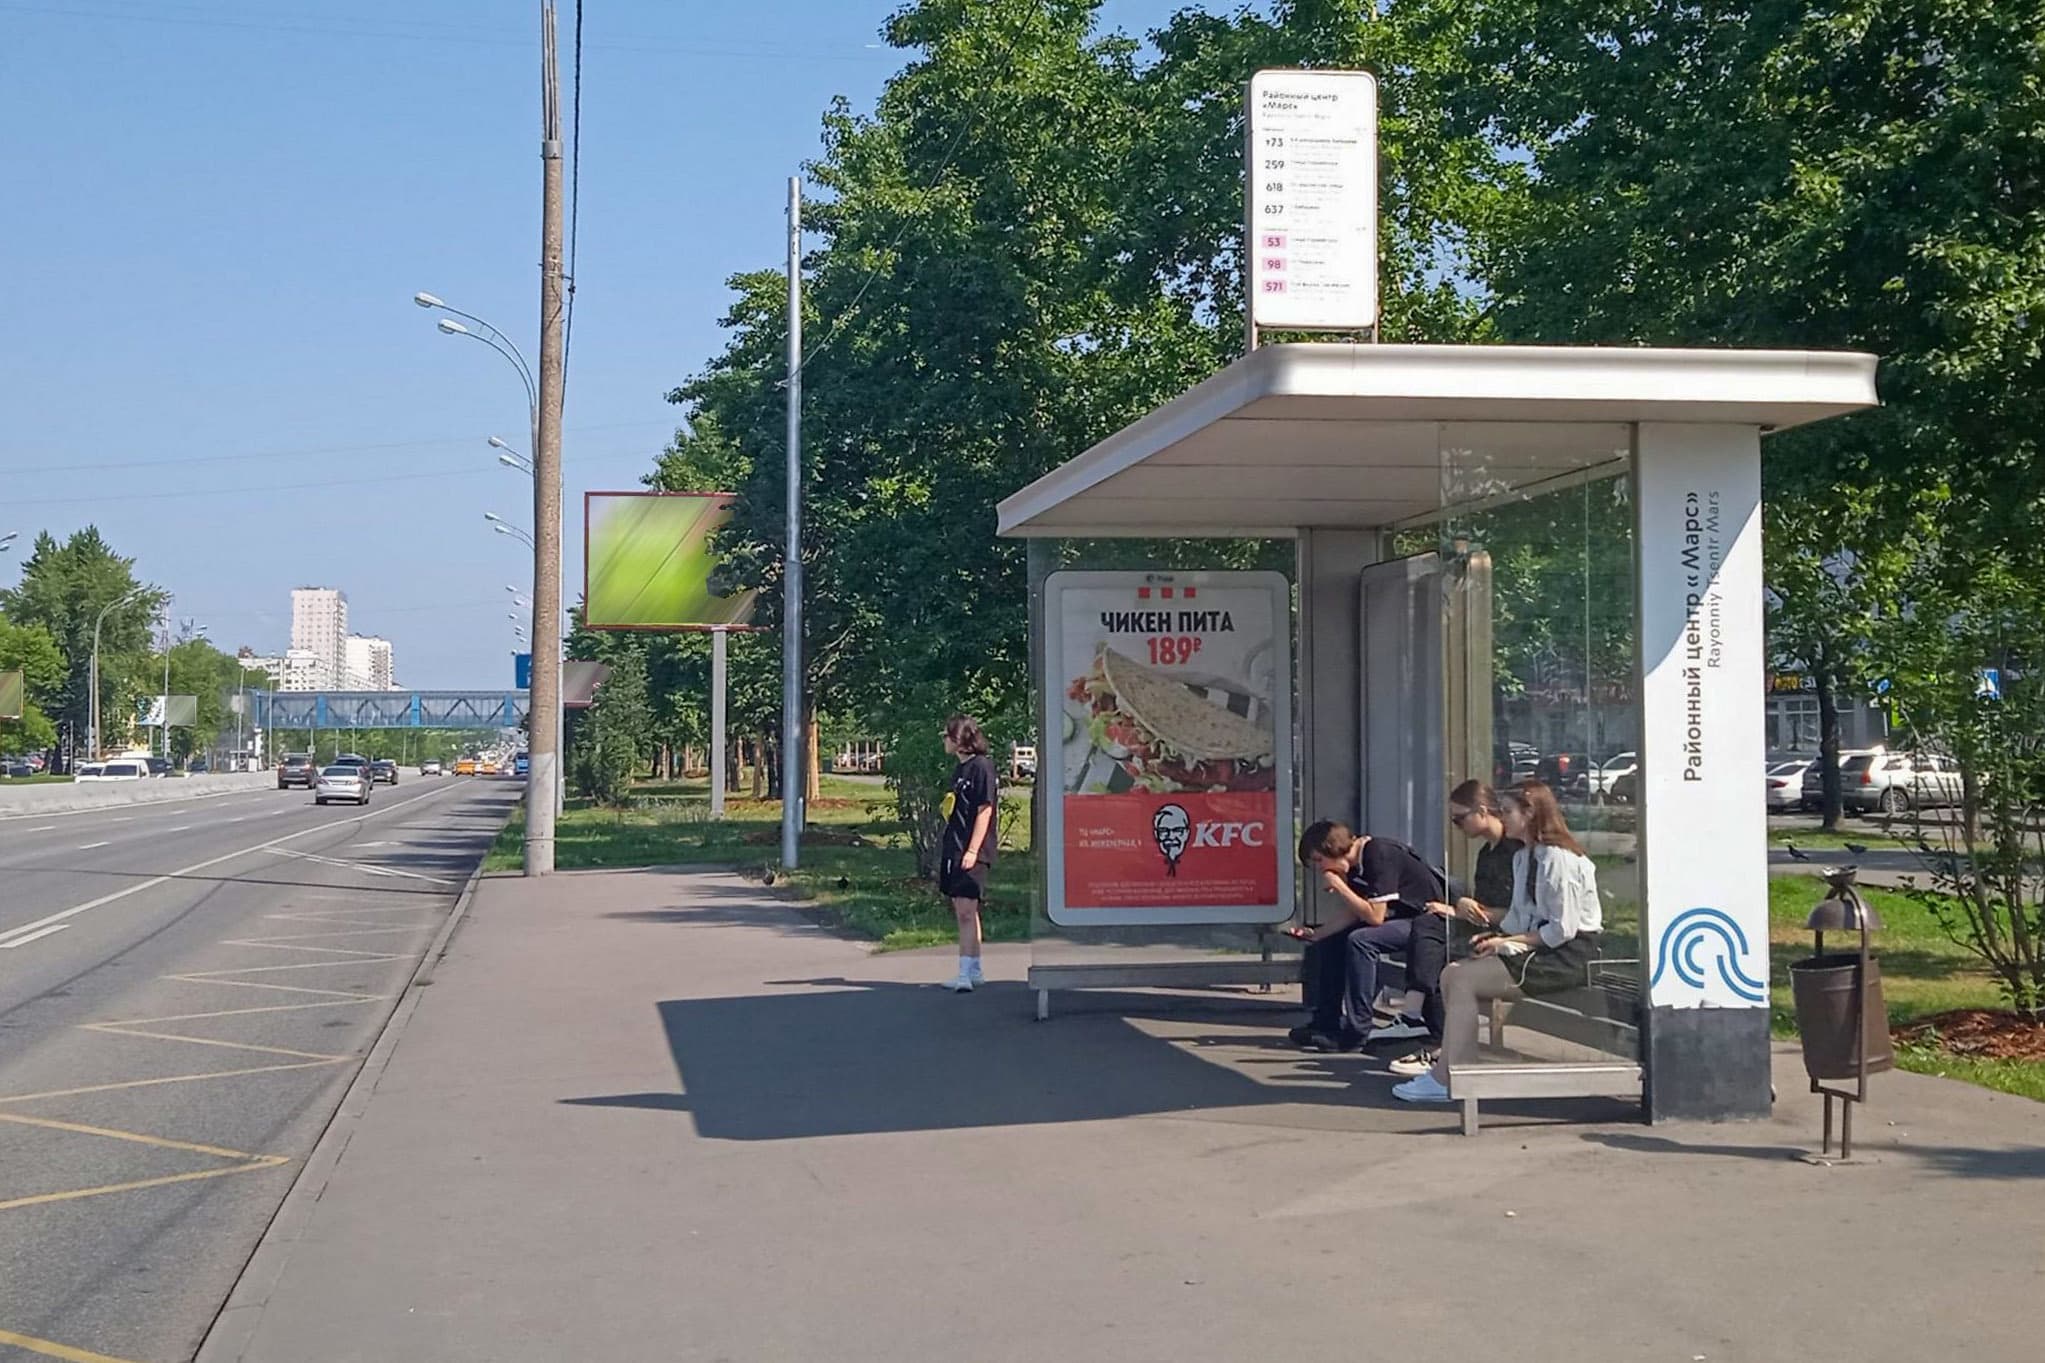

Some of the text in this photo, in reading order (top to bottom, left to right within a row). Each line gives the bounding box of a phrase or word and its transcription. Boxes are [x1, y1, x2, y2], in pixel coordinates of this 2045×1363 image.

[1264, 159, 1285, 170] 259
[1265, 182, 1284, 192] 618
[1264, 204, 1284, 215] 637
[1267, 237, 1281, 247] 53
[1267, 259, 1281, 270] 98
[1265, 281, 1283, 292] 571
[1706, 490, 1723, 668] Rayonniy Tsentr Mars
[1101, 610, 1235, 633] ЧИКЕН ПИТА
[1680, 492, 1704, 782] Районный центр «Марс»
[1192, 821, 1264, 848] KFC
